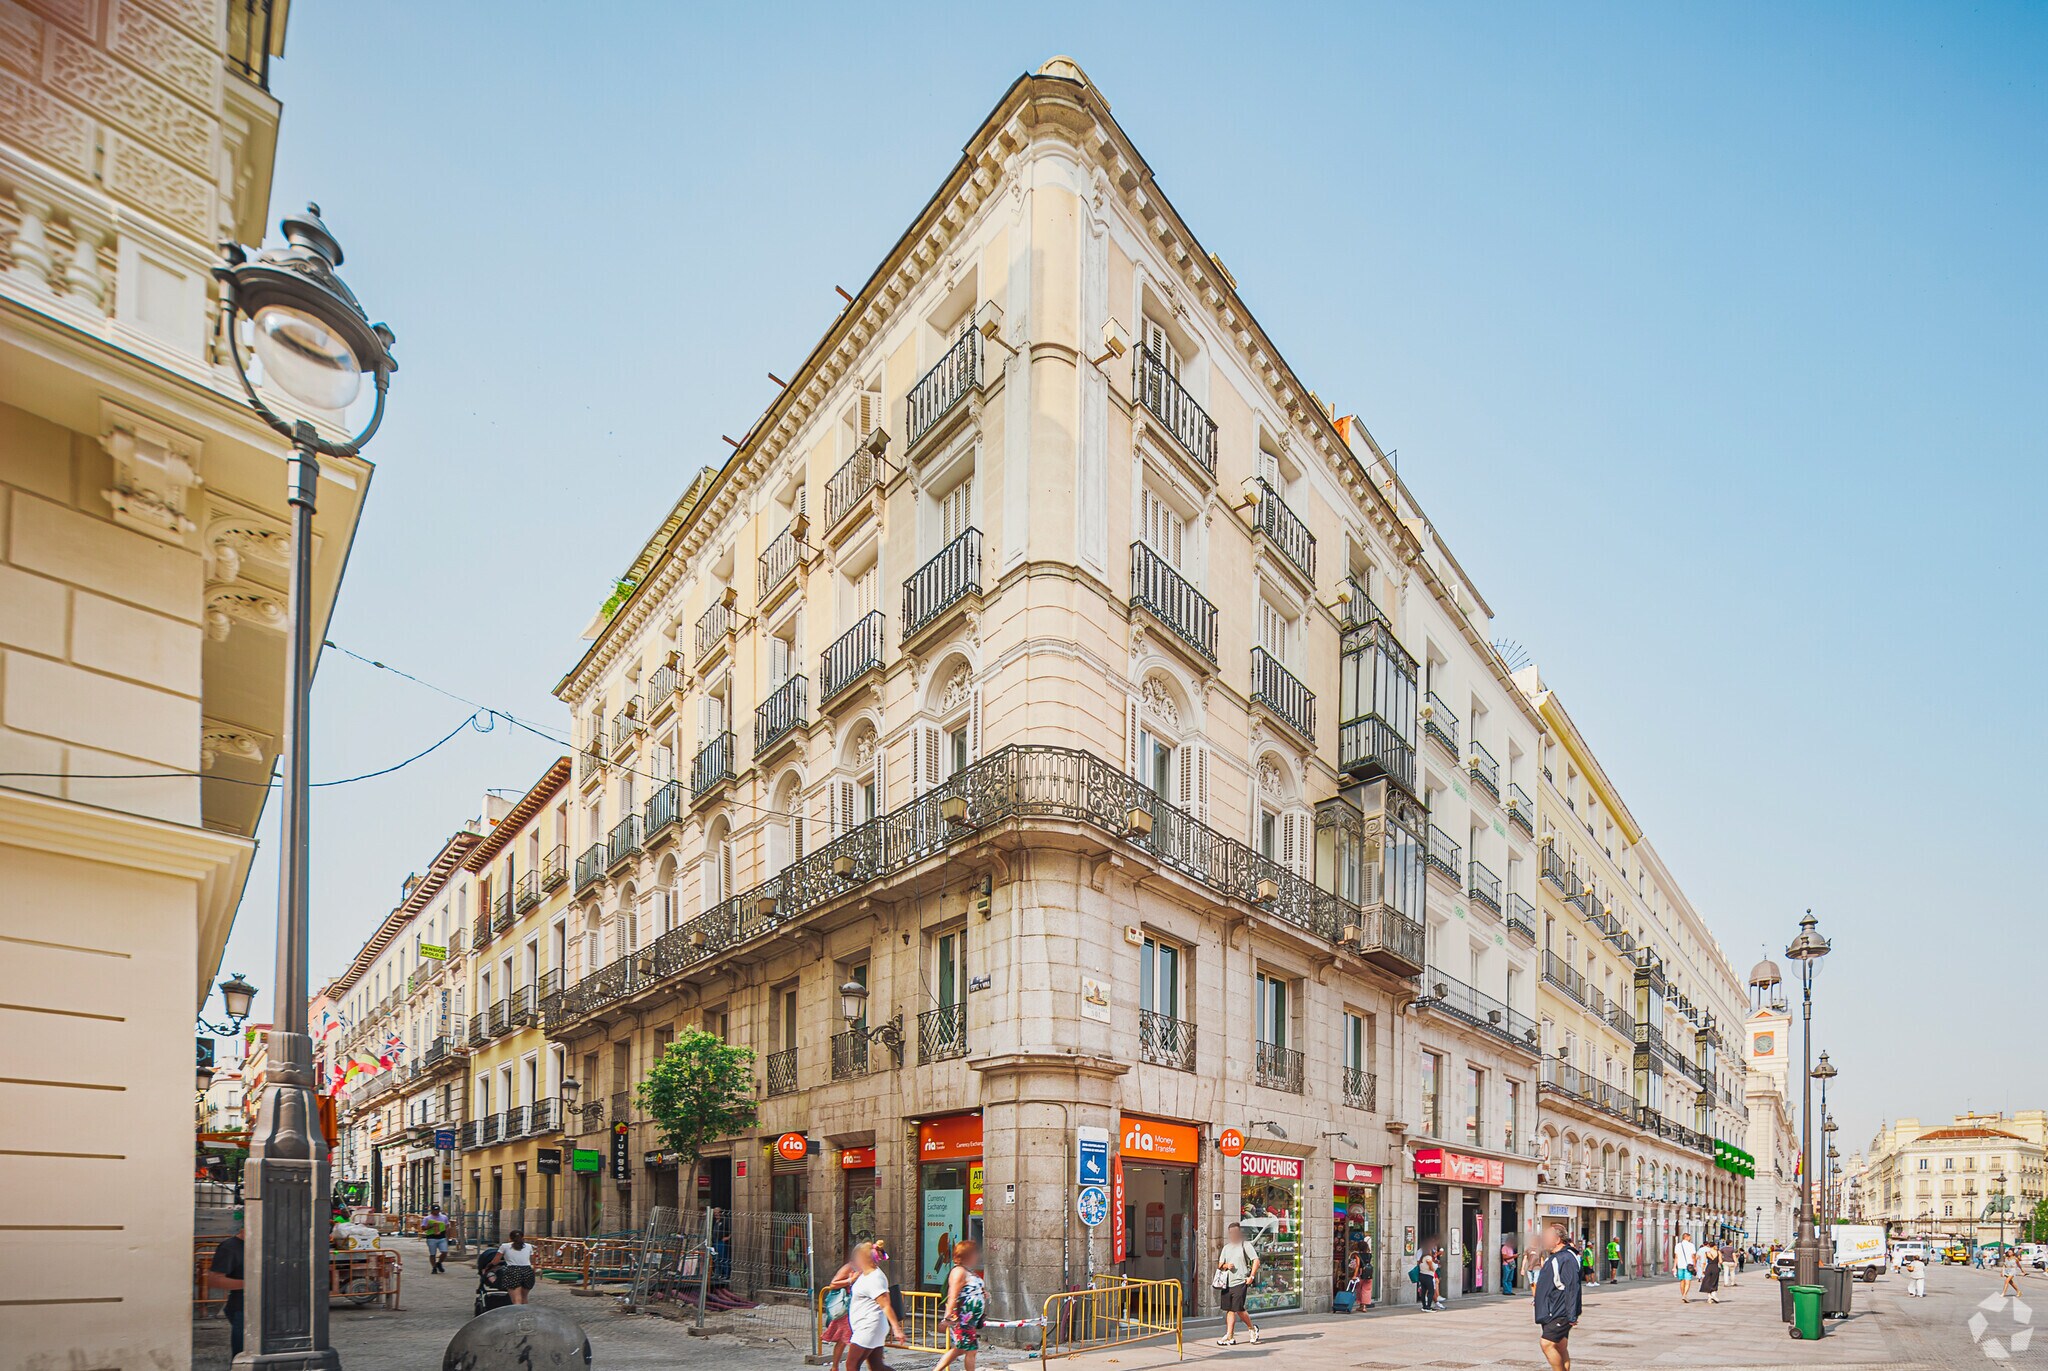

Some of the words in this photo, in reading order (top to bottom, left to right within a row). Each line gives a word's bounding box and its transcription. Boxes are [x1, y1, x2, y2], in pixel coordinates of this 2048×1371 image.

[783, 1136, 803, 1150] ria
[1125, 1123, 1153, 1151] ria
[1154, 1135, 1174, 1145] Money
[1222, 1132, 1240, 1147] ria
[925, 1138, 936, 1151] ria
[1154, 1143, 1176, 1153] Transfer
[617, 1135, 625, 1179] Juegos
[843, 1152, 853, 1164] ria
[1242, 1156, 1298, 1177] SOUVENIRS
[927, 1194, 946, 1203] Currency
[927, 1203, 948, 1212] Exchange
